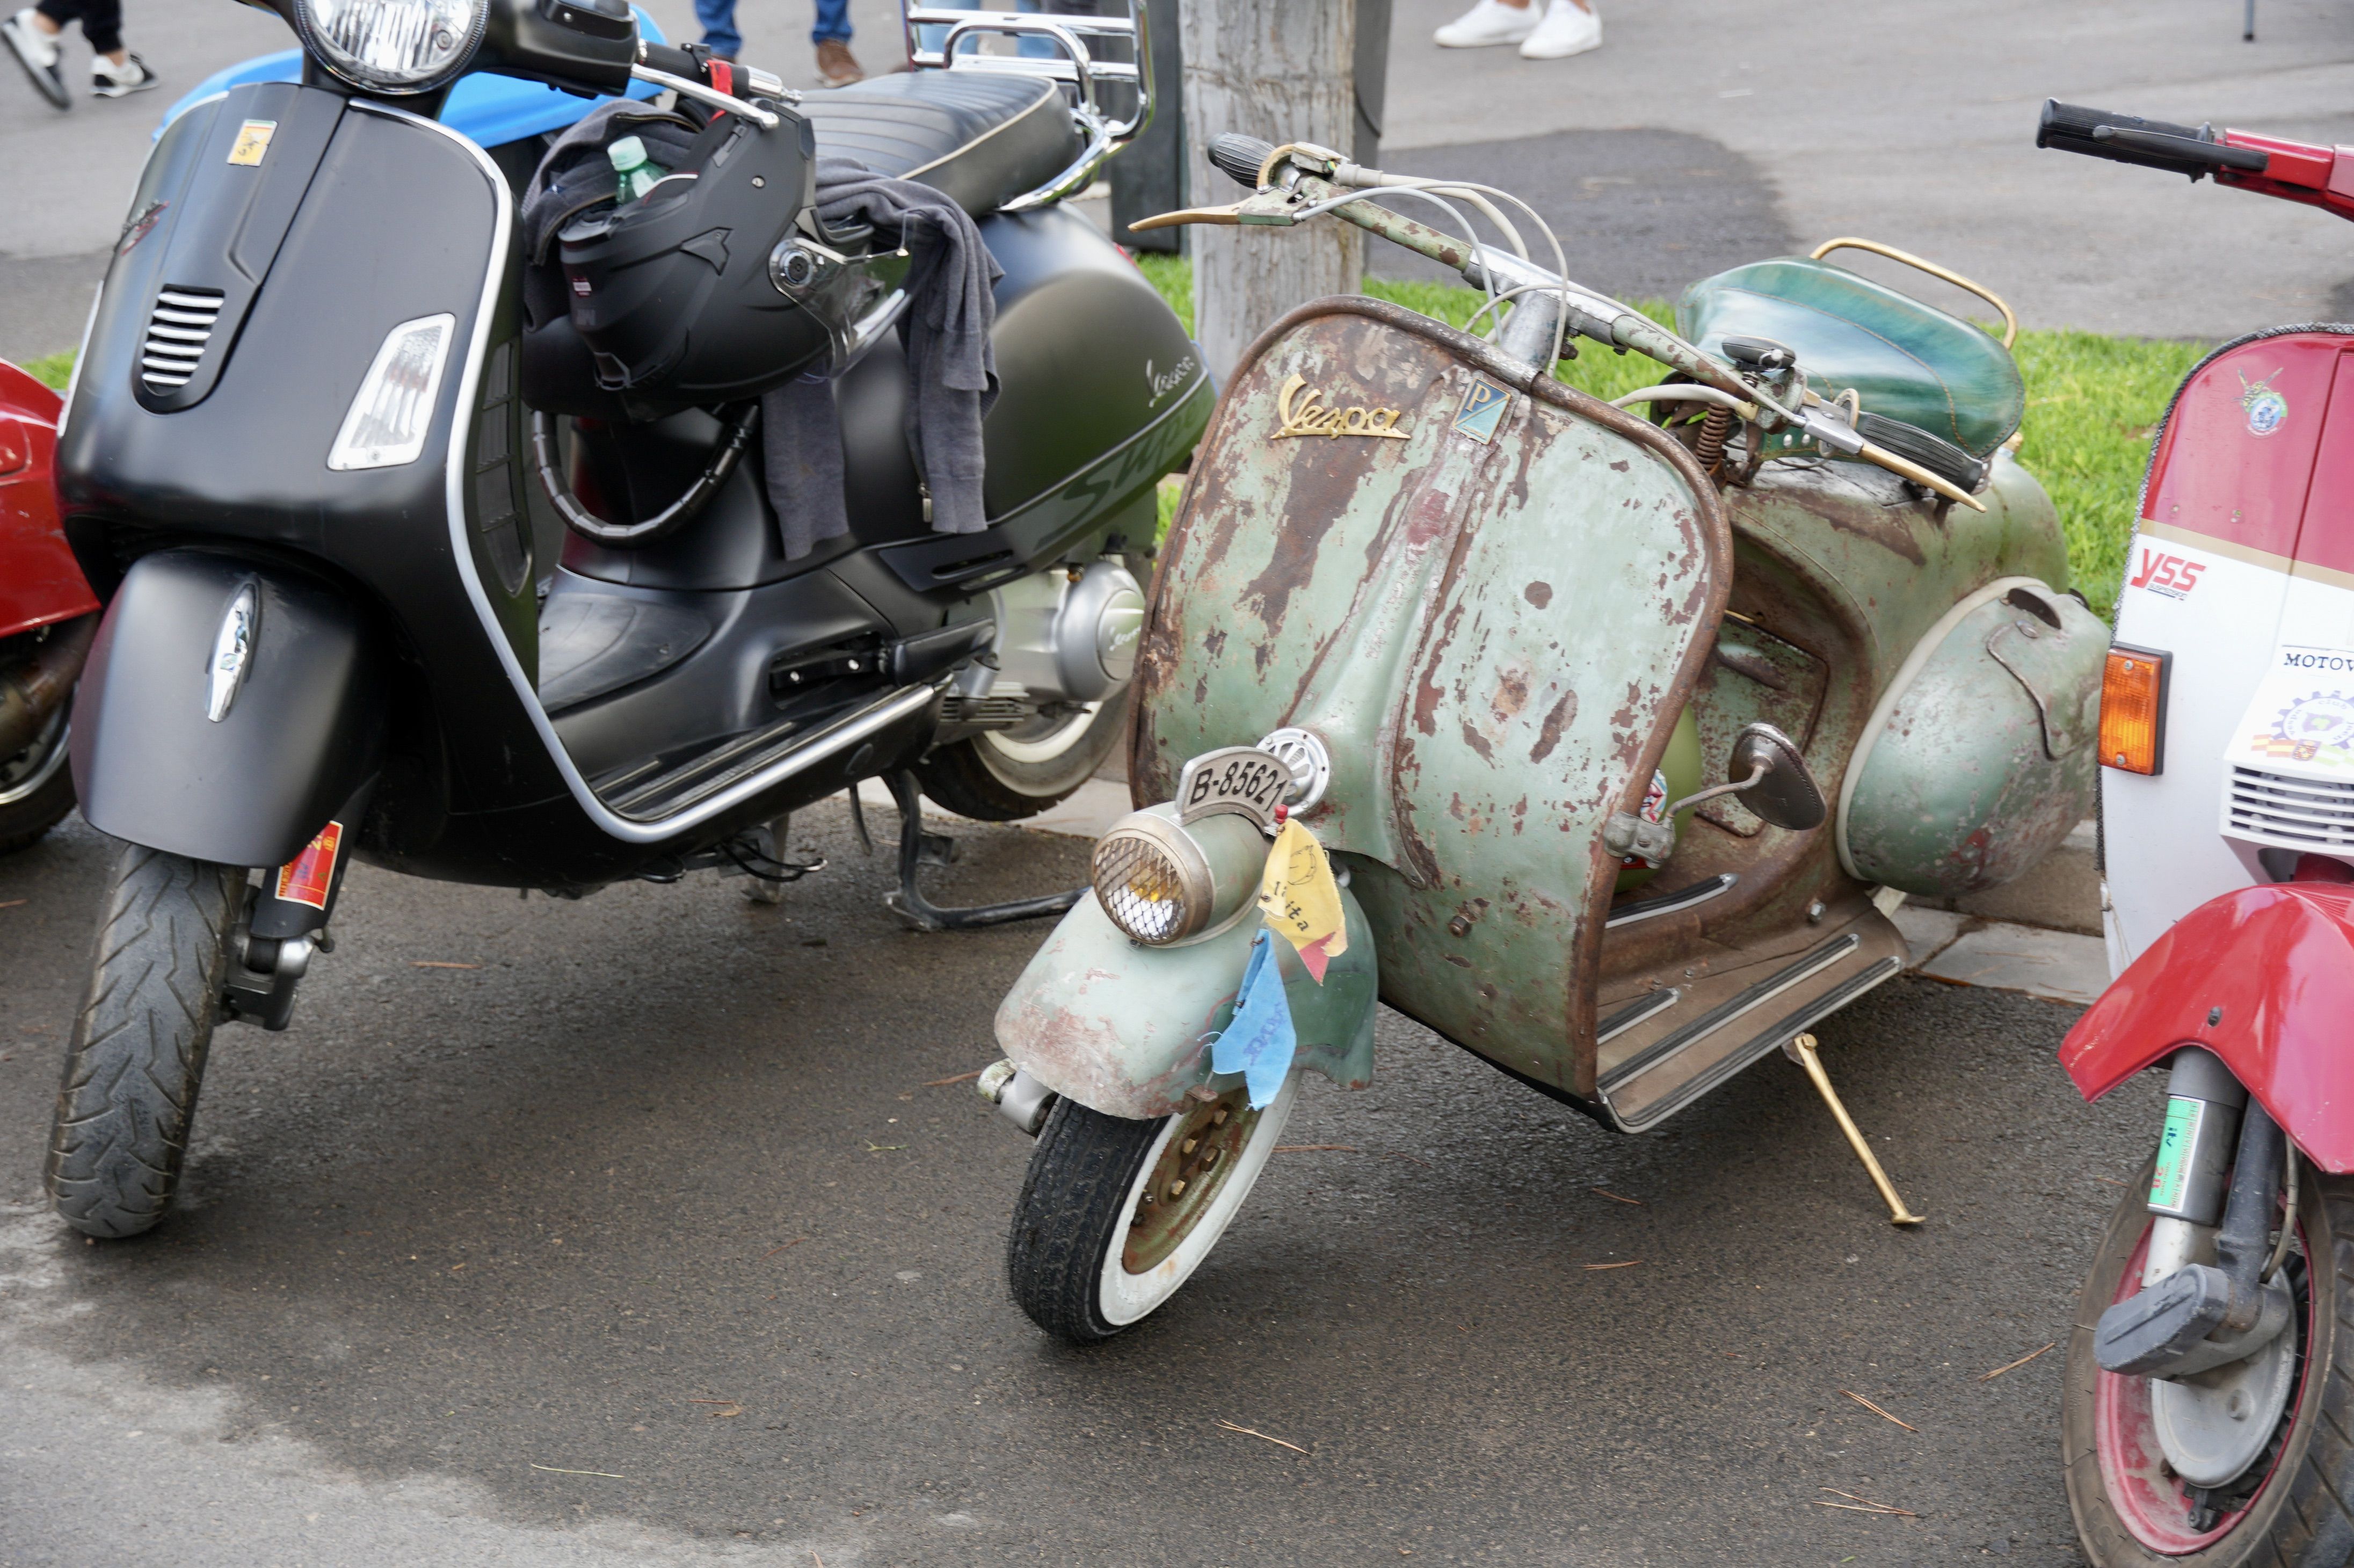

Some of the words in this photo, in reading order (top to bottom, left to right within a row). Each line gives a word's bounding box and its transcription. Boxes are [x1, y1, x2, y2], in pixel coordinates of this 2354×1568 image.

[1146, 356, 1195, 408] Vespa
[1270, 373, 1412, 440] Vespa
[1464, 383, 1491, 412] P
[1190, 761, 1288, 812] B-85621
